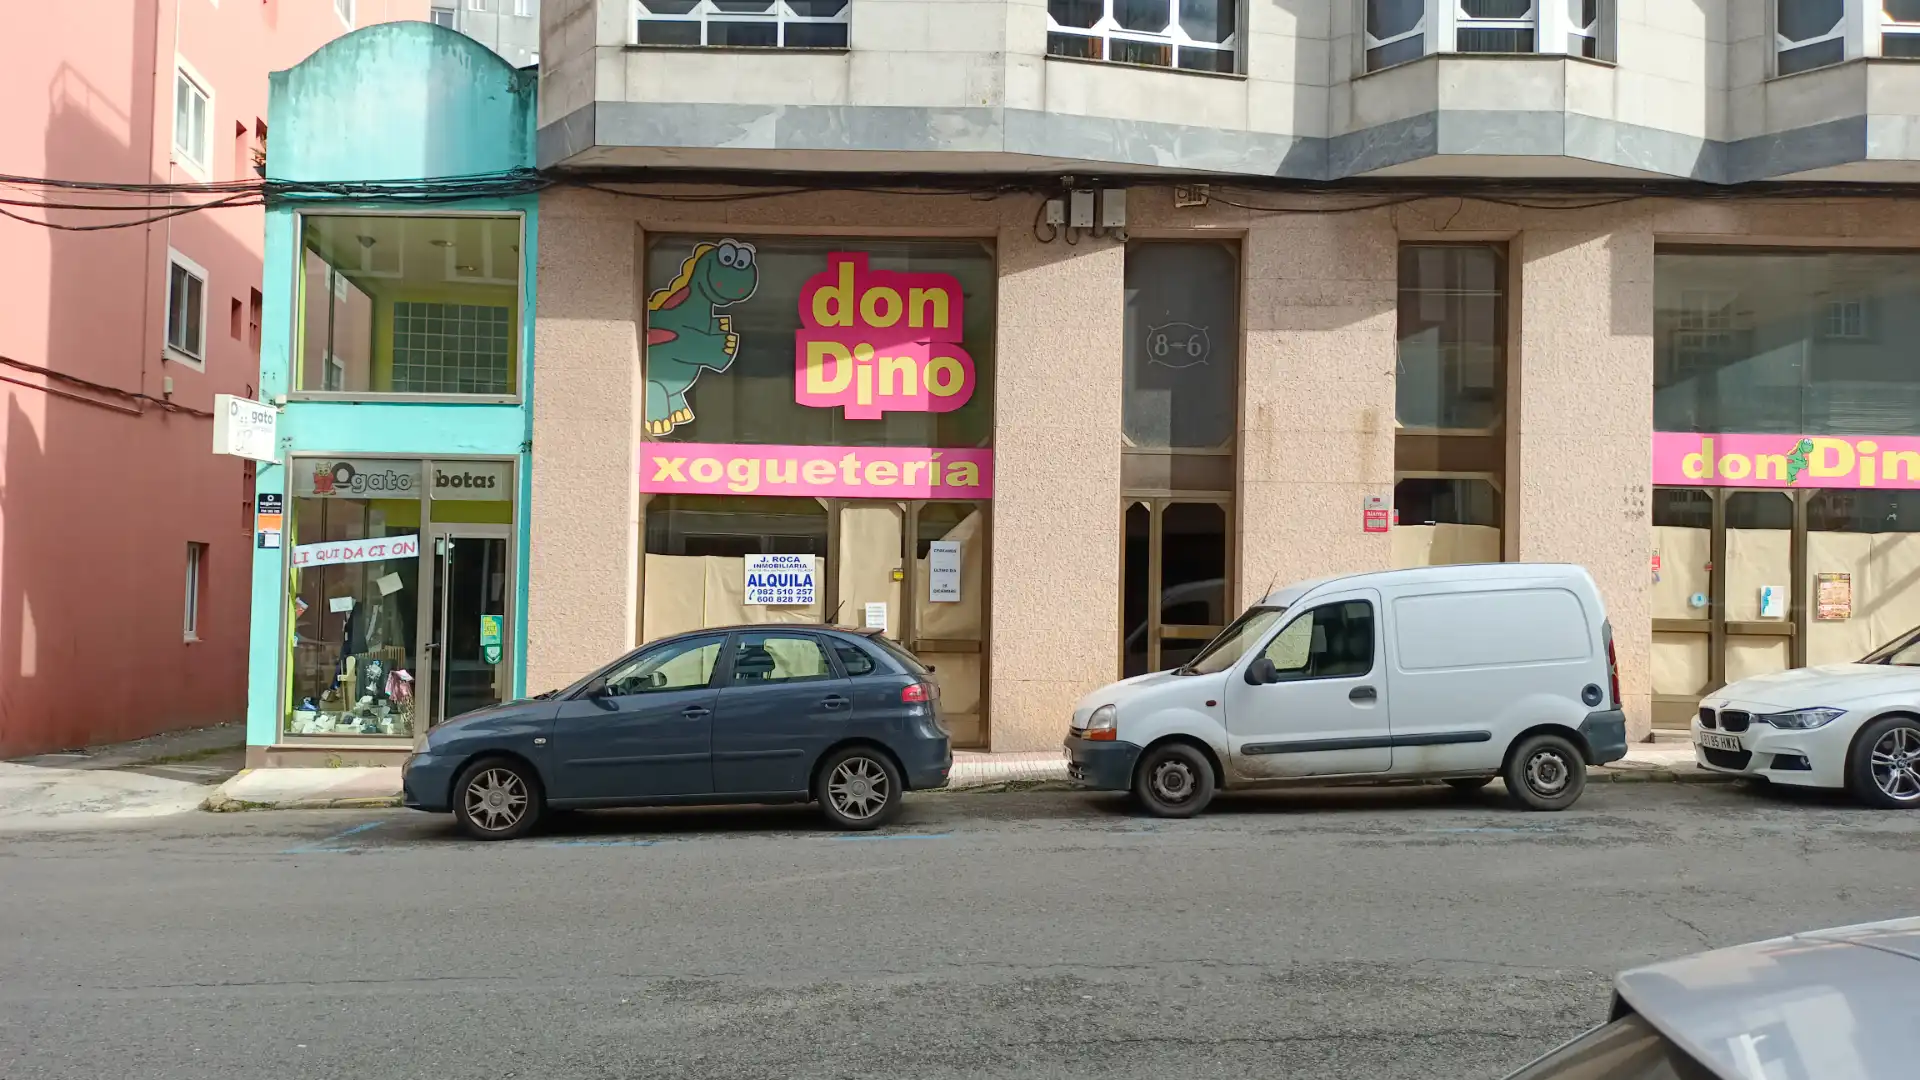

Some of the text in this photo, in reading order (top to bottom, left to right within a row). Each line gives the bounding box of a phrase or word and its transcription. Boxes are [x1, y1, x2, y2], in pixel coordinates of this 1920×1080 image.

[812, 262, 949, 328] don
[806, 341, 965, 405] Dino
[251, 410, 273, 425] gato
[652, 452, 980, 492] xoguetería
[1682, 437, 1788, 480] don
[435, 469, 496, 489] botas
[747, 573, 813, 588] ALQUILA
